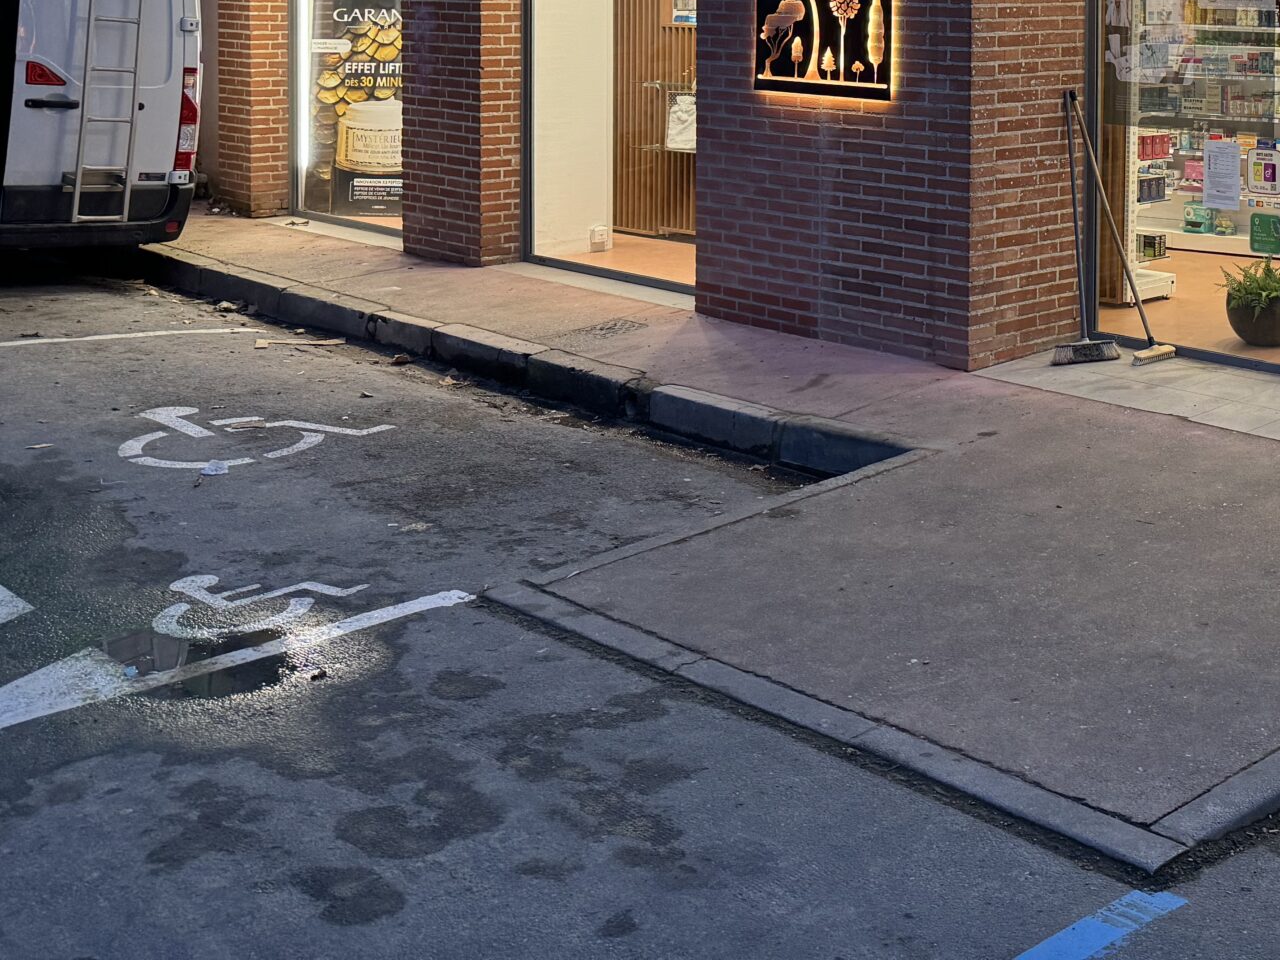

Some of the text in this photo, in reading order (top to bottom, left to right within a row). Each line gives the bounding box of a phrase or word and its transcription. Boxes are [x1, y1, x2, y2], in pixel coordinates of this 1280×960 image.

[345, 62, 376, 74] EFFET
[345, 78, 359, 87] DÈS
[360, 76, 373, 87] 30
